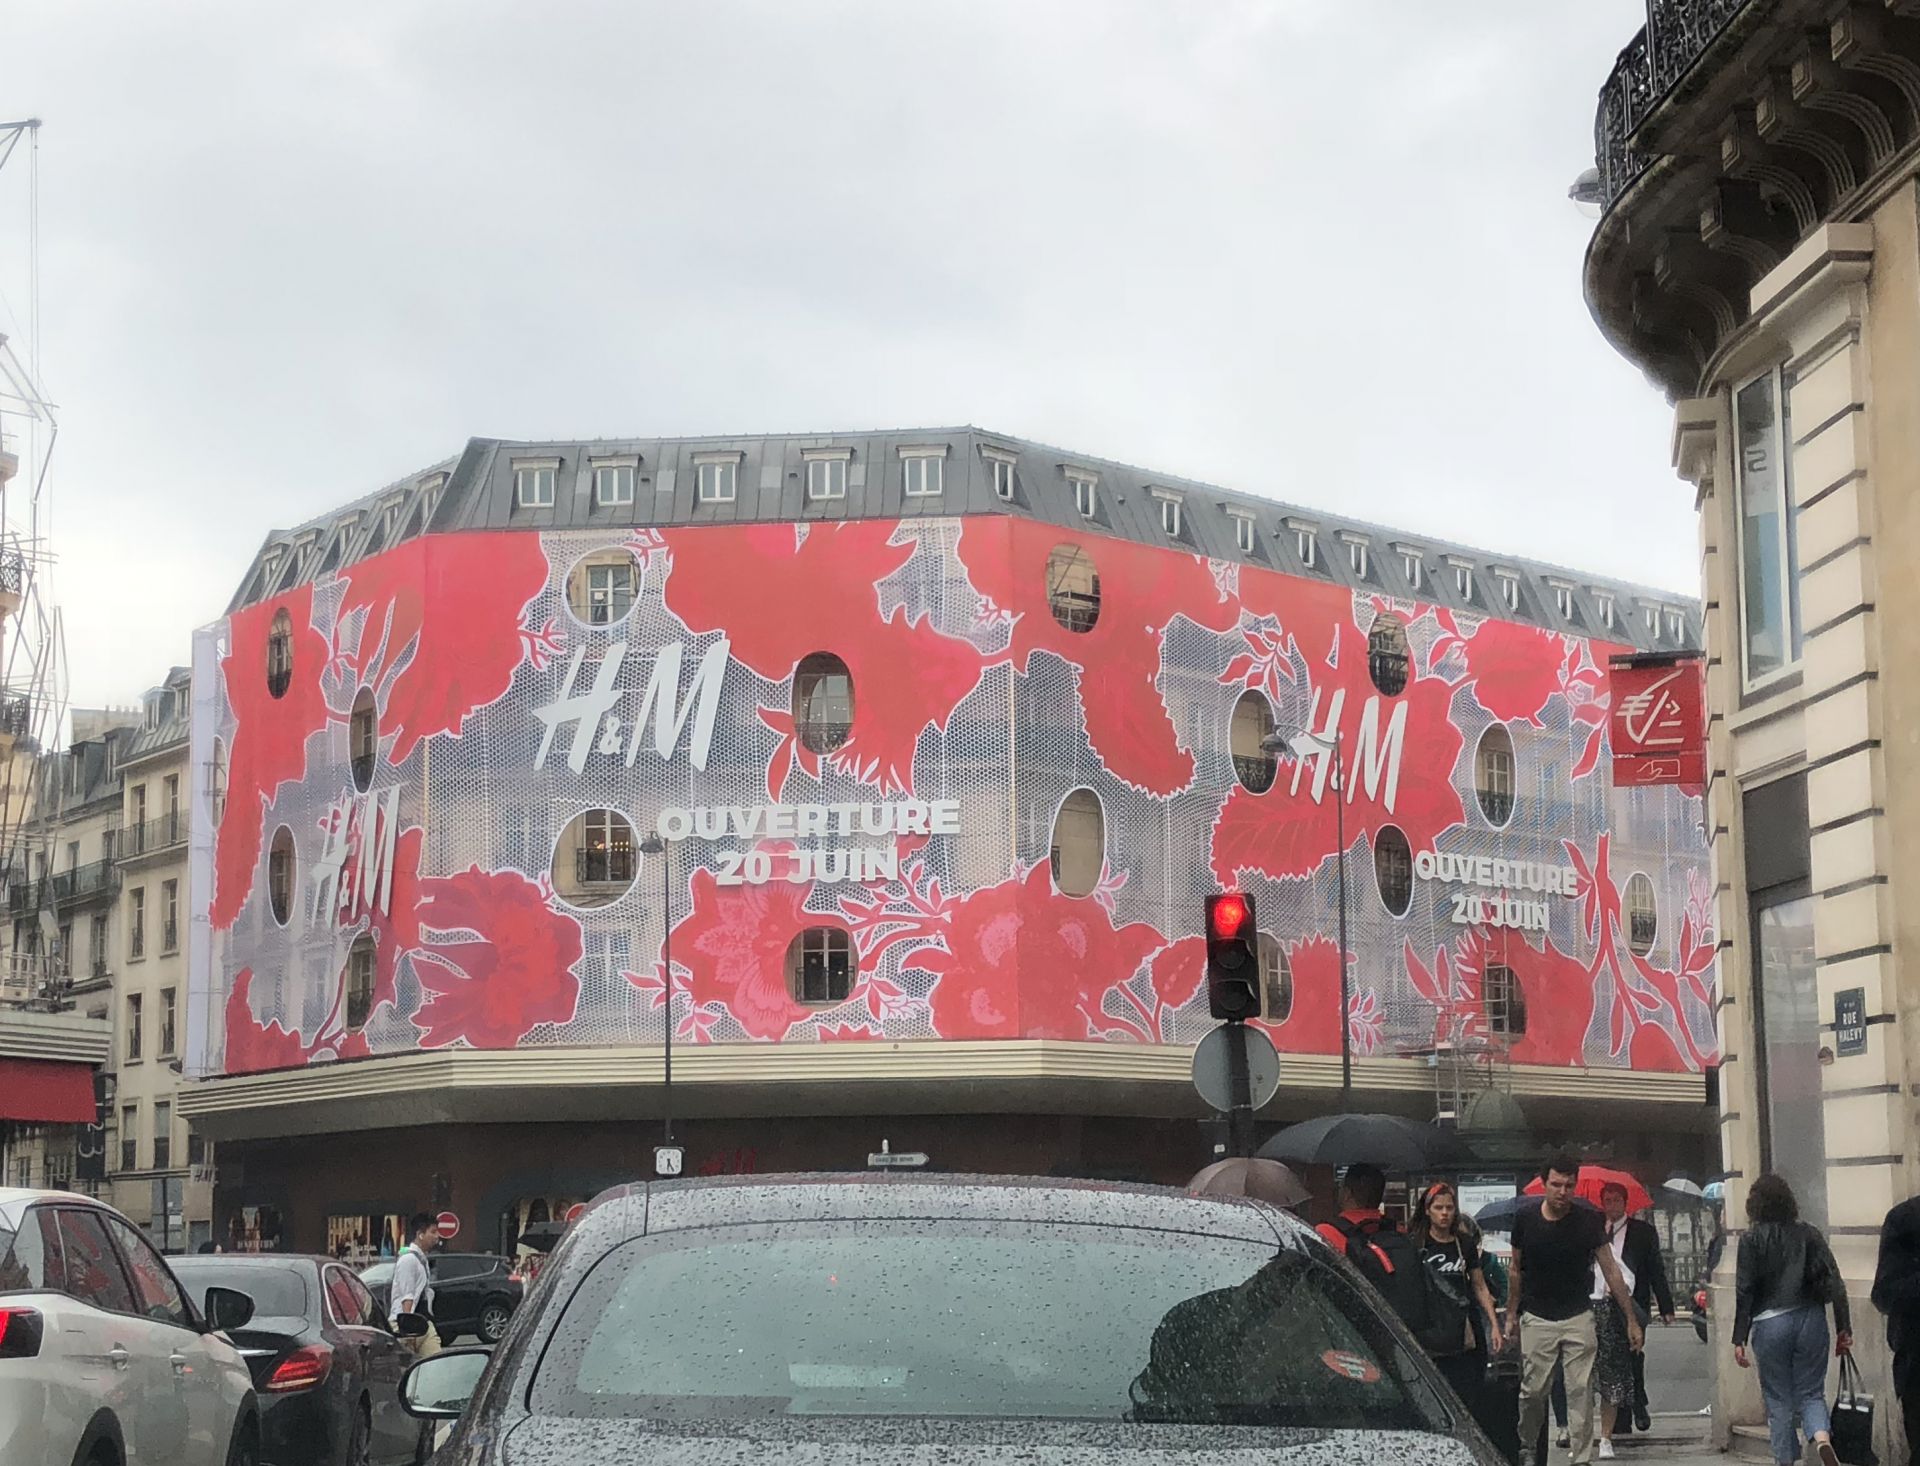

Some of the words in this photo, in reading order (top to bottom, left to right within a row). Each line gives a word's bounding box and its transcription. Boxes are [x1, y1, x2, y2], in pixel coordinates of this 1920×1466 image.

[531, 639, 731, 775] H&M
[1289, 686, 1409, 816] H&M
[657, 799, 961, 842] OUVERTURE
[311, 784, 401, 929] H&M
[715, 851, 772, 886] 20
[787, 846, 899, 884] JUIN
[1415, 849, 1578, 896] OUVERTURE
[1451, 893, 1482, 925] 20
[1490, 896, 1550, 932] JUIN
[1842, 1011, 1857, 1025] RUE
